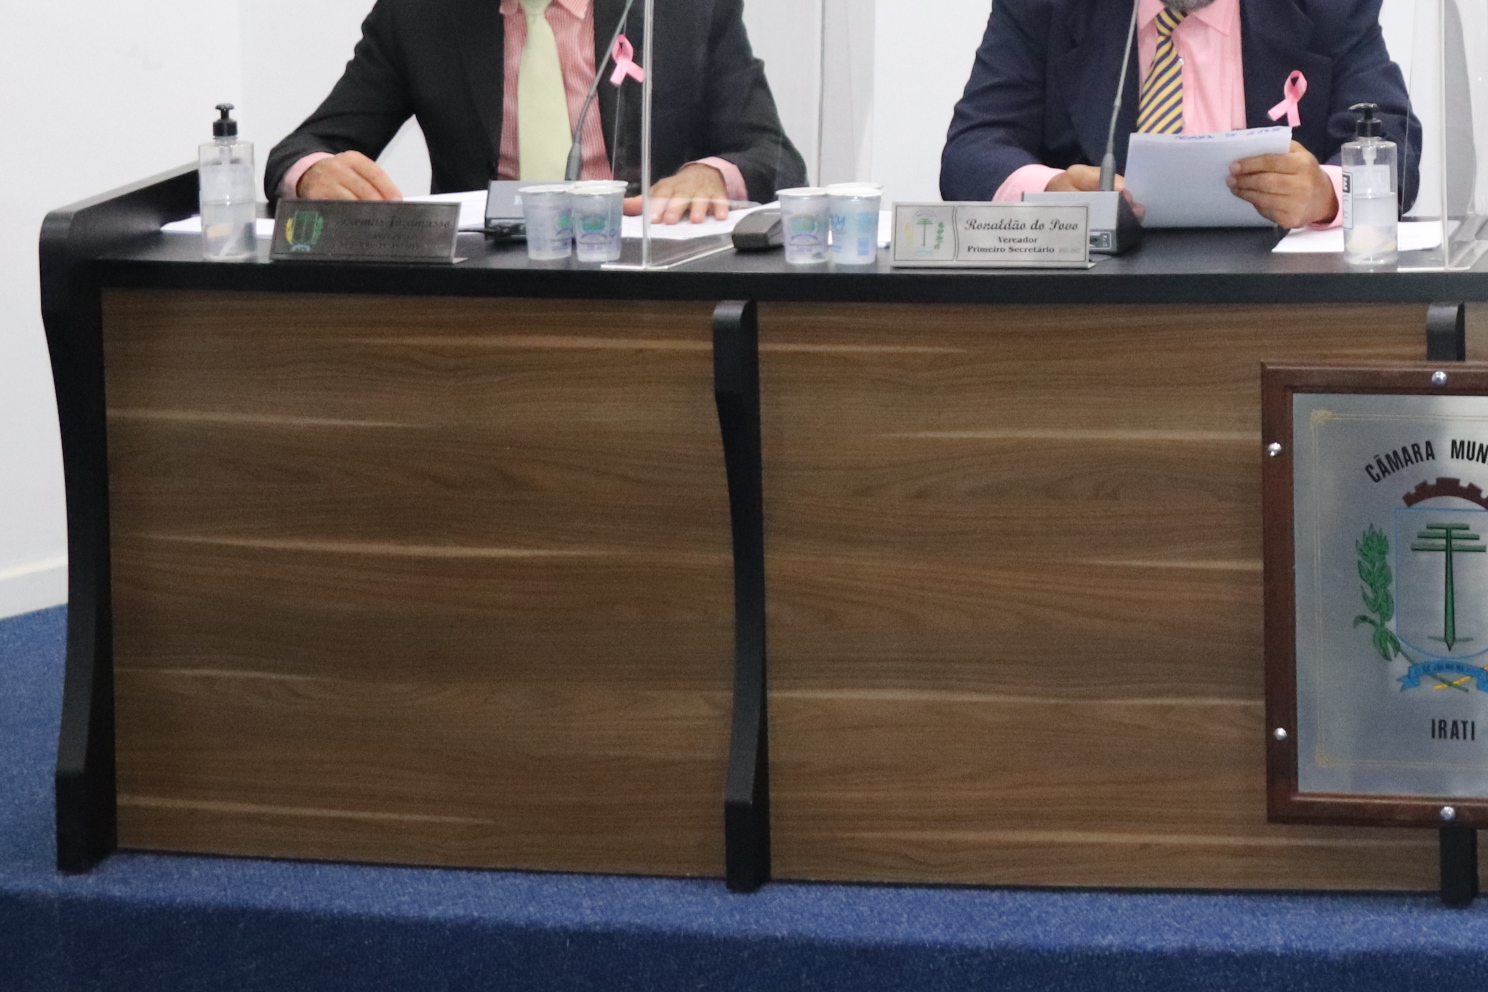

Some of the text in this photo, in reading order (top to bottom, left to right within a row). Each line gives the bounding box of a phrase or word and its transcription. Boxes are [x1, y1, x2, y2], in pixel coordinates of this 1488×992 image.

[965, 218, 1078, 231] Ronaldão do Povo
[998, 235, 1038, 244] Vereador
[967, 245, 1005, 254] Primeiro
[1431, 718, 1476, 741] IRATI
